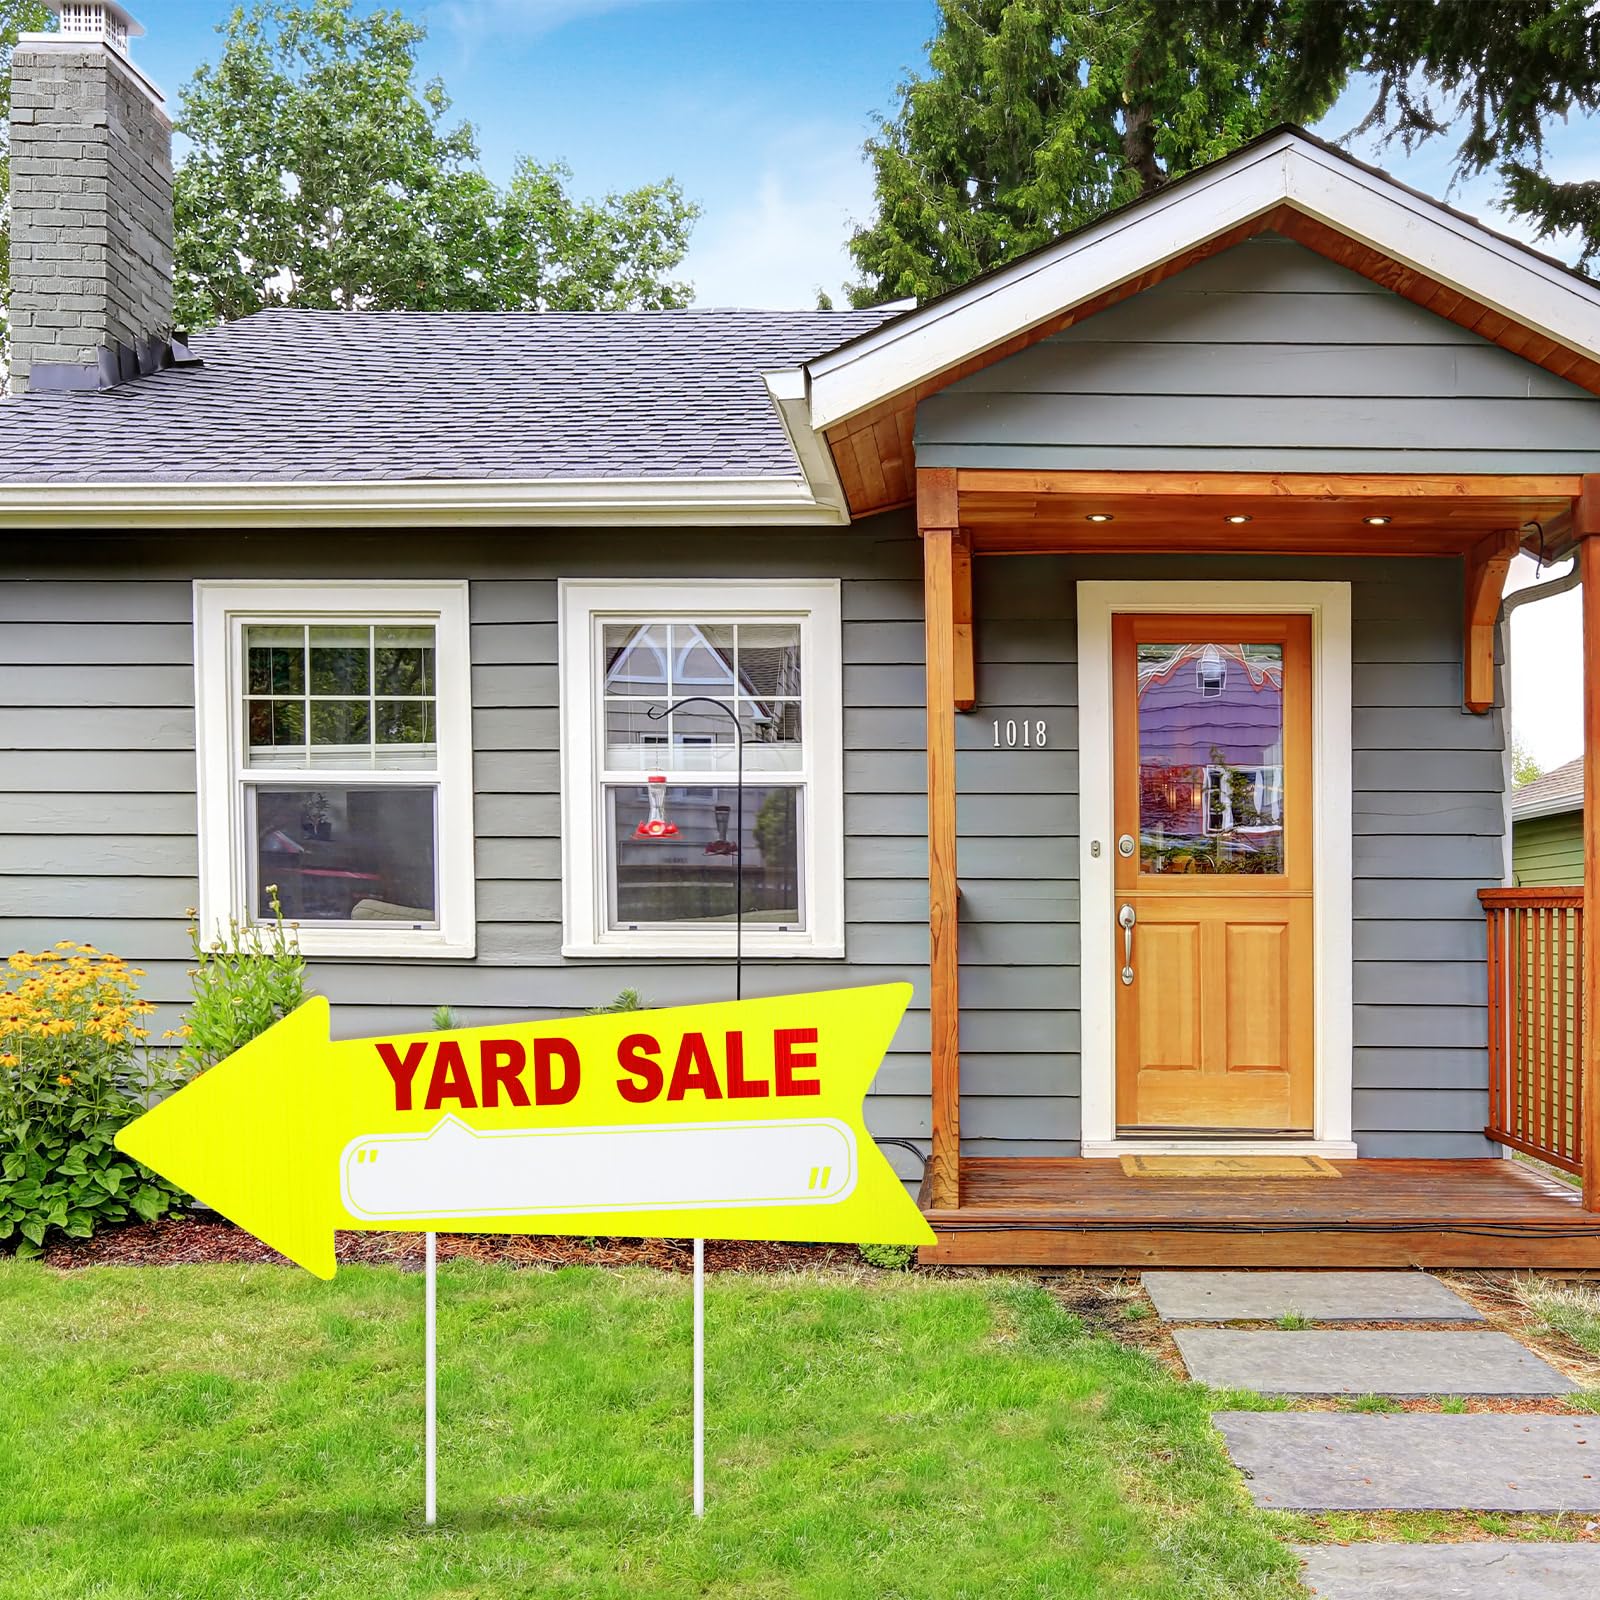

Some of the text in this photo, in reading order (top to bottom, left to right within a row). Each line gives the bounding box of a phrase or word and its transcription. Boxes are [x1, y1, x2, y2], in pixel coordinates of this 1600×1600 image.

[993, 719, 1046, 747] 1018
[374, 1027, 821, 1111] YARD SALE
